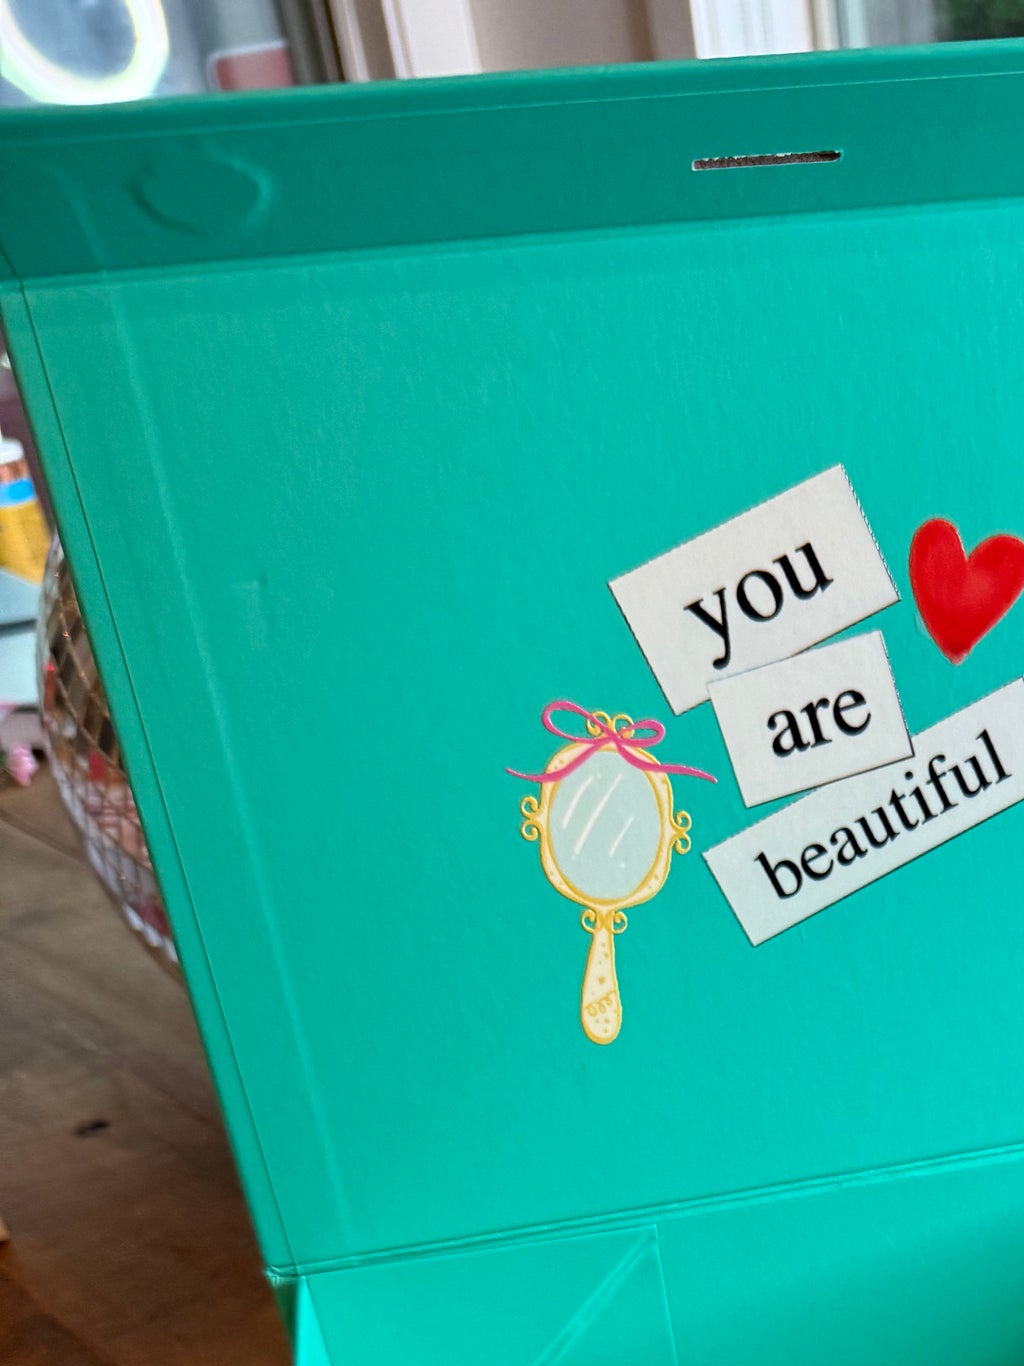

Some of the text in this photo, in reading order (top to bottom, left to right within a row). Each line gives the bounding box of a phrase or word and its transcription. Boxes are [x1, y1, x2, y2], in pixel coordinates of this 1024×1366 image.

[683, 541, 834, 670] you
[766, 689, 872, 758] are
[753, 728, 1013, 900] beautiful
